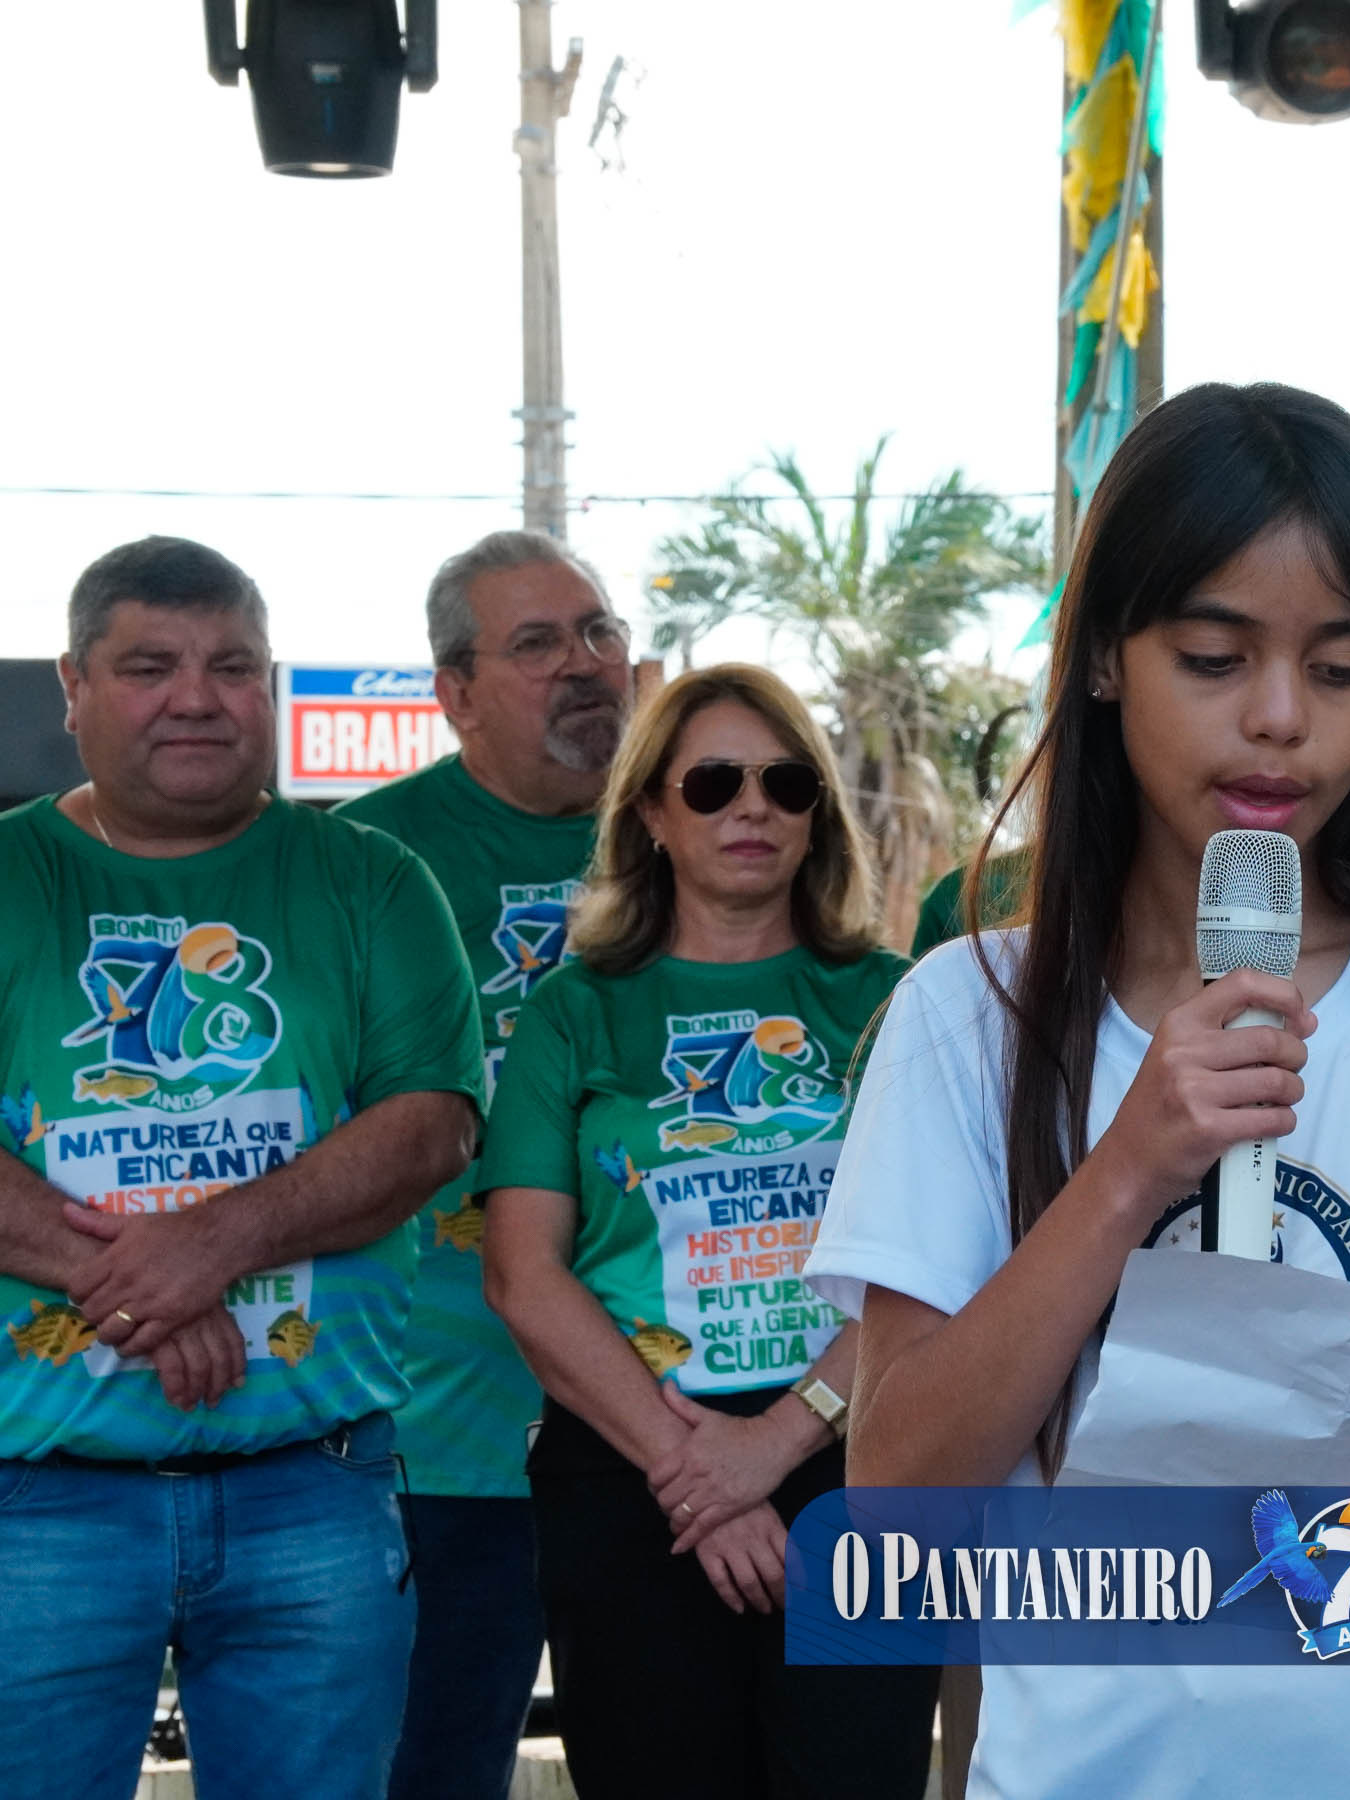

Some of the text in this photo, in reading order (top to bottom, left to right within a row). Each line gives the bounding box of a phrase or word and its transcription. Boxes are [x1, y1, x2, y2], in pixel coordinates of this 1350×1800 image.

[95, 917, 182, 939] BONITO
[672, 1014, 754, 1034] BONITO
[150, 1083, 214, 1109] ANOS
[59, 1117, 293, 1161] NATUREZA QUE
[732, 1131, 793, 1153] ANOS
[117, 1145, 287, 1186] ENCANTA
[655, 1162, 811, 1205] NATUREZA
[687, 1266, 725, 1288] QUE
[697, 1278, 817, 1313] FUTURO
[700, 1319, 744, 1341] QUE
[751, 1317, 761, 1335] A
